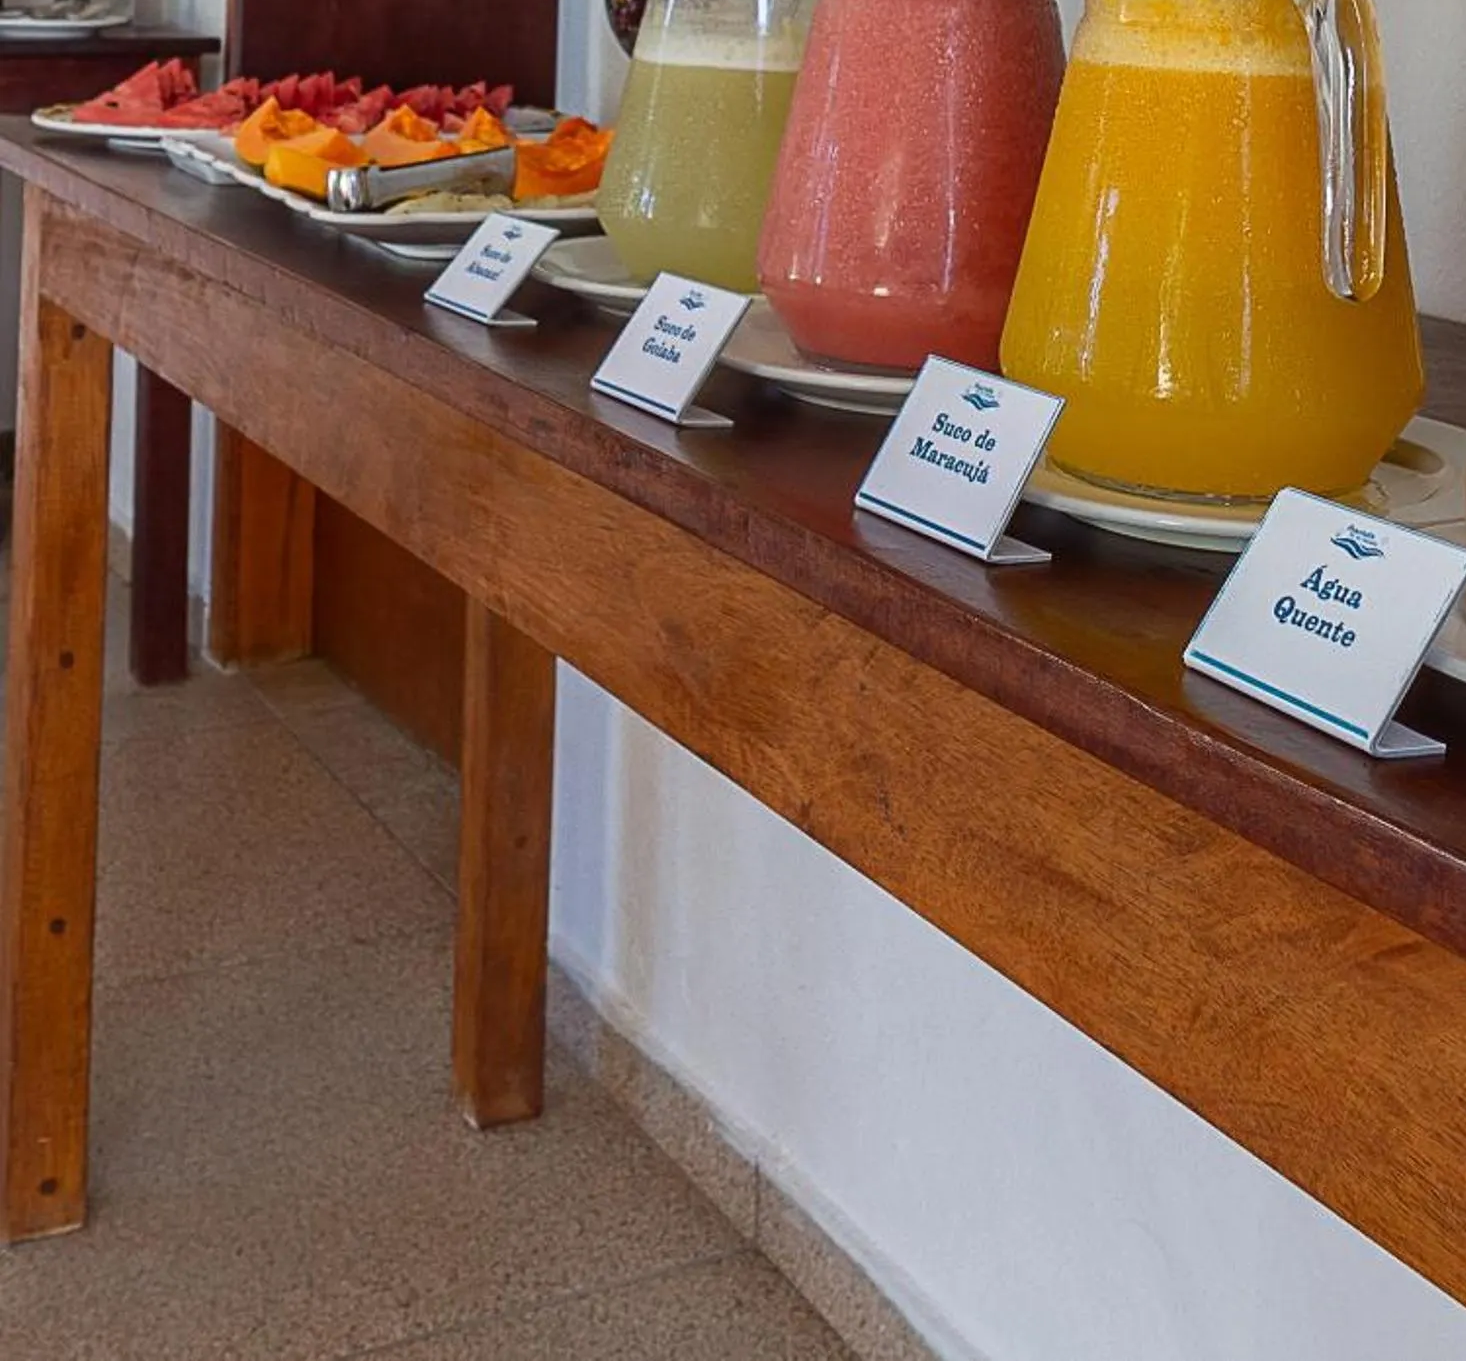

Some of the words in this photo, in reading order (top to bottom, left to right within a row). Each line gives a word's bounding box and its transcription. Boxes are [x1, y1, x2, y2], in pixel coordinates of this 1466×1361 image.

[680, 324, 697, 342] de
[931, 412, 972, 444] Suco
[974, 429, 996, 452] de
[909, 436, 990, 485] Maracujá
[1300, 564, 1363, 610] Água
[1273, 595, 1356, 648] Quente
